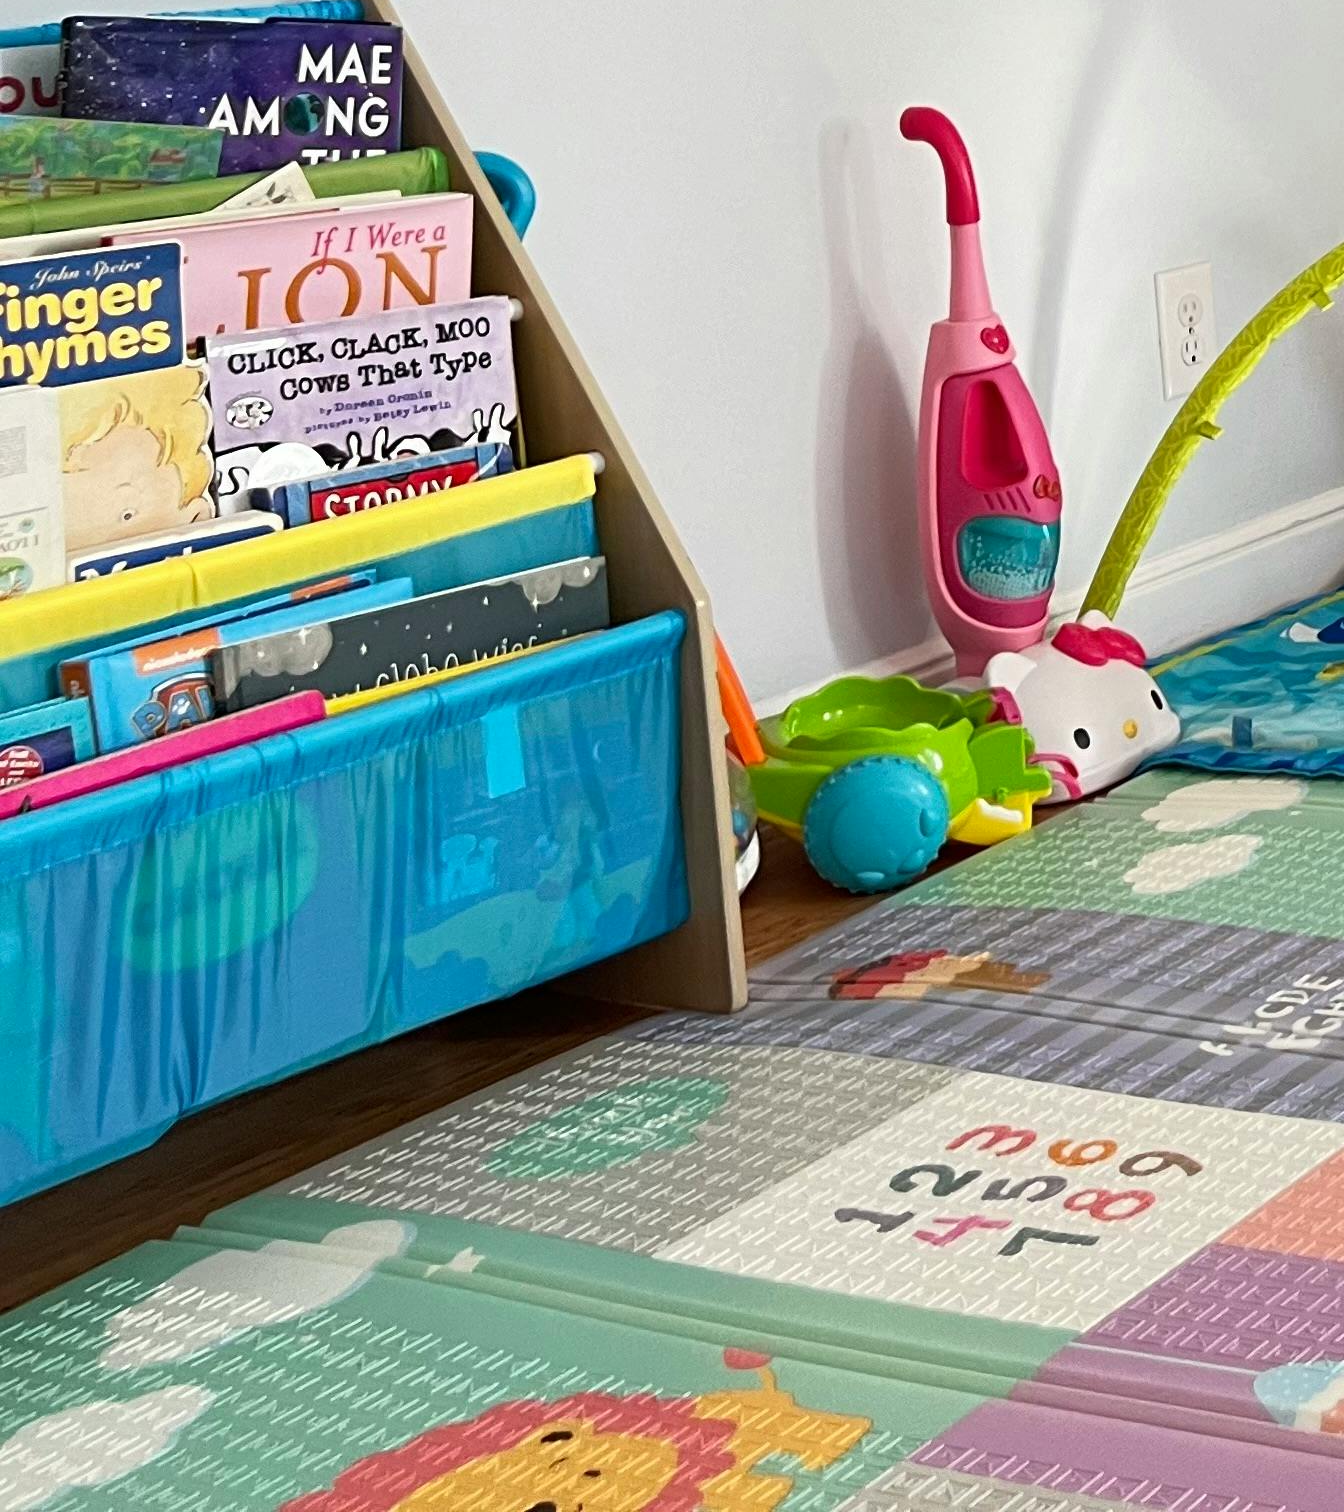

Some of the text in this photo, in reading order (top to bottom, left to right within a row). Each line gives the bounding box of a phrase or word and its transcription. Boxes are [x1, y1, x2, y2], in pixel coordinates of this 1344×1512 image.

[297, 42, 393, 85] MAE
[311, 222, 446, 275] If I Were a
[30, 265, 80, 290] John
[216, 245, 447, 334] ION
[0, 277, 162, 333] inger
[227, 316, 491, 375] CLICK, CLACK, MOO
[280, 350, 493, 401] Cows That Type
